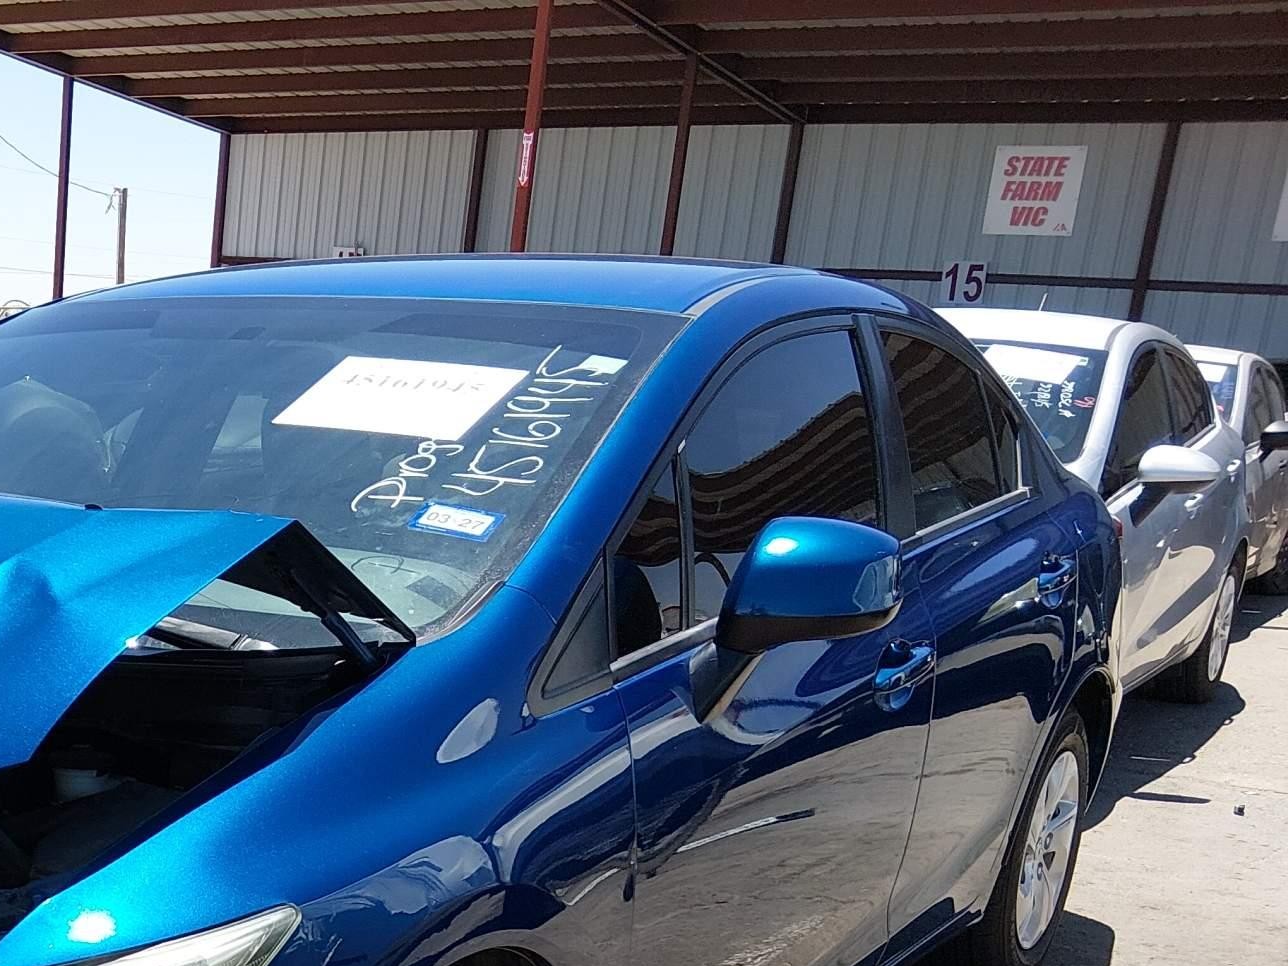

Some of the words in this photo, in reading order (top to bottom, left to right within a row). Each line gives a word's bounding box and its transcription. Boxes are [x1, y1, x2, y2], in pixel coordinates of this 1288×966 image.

[1003, 155, 1071, 177] STATE
[1000, 180, 1064, 202] FARM
[1009, 206, 1049, 227] VIC
[944, 263, 985, 302] 15
[441, 344, 609, 497] 45161945
